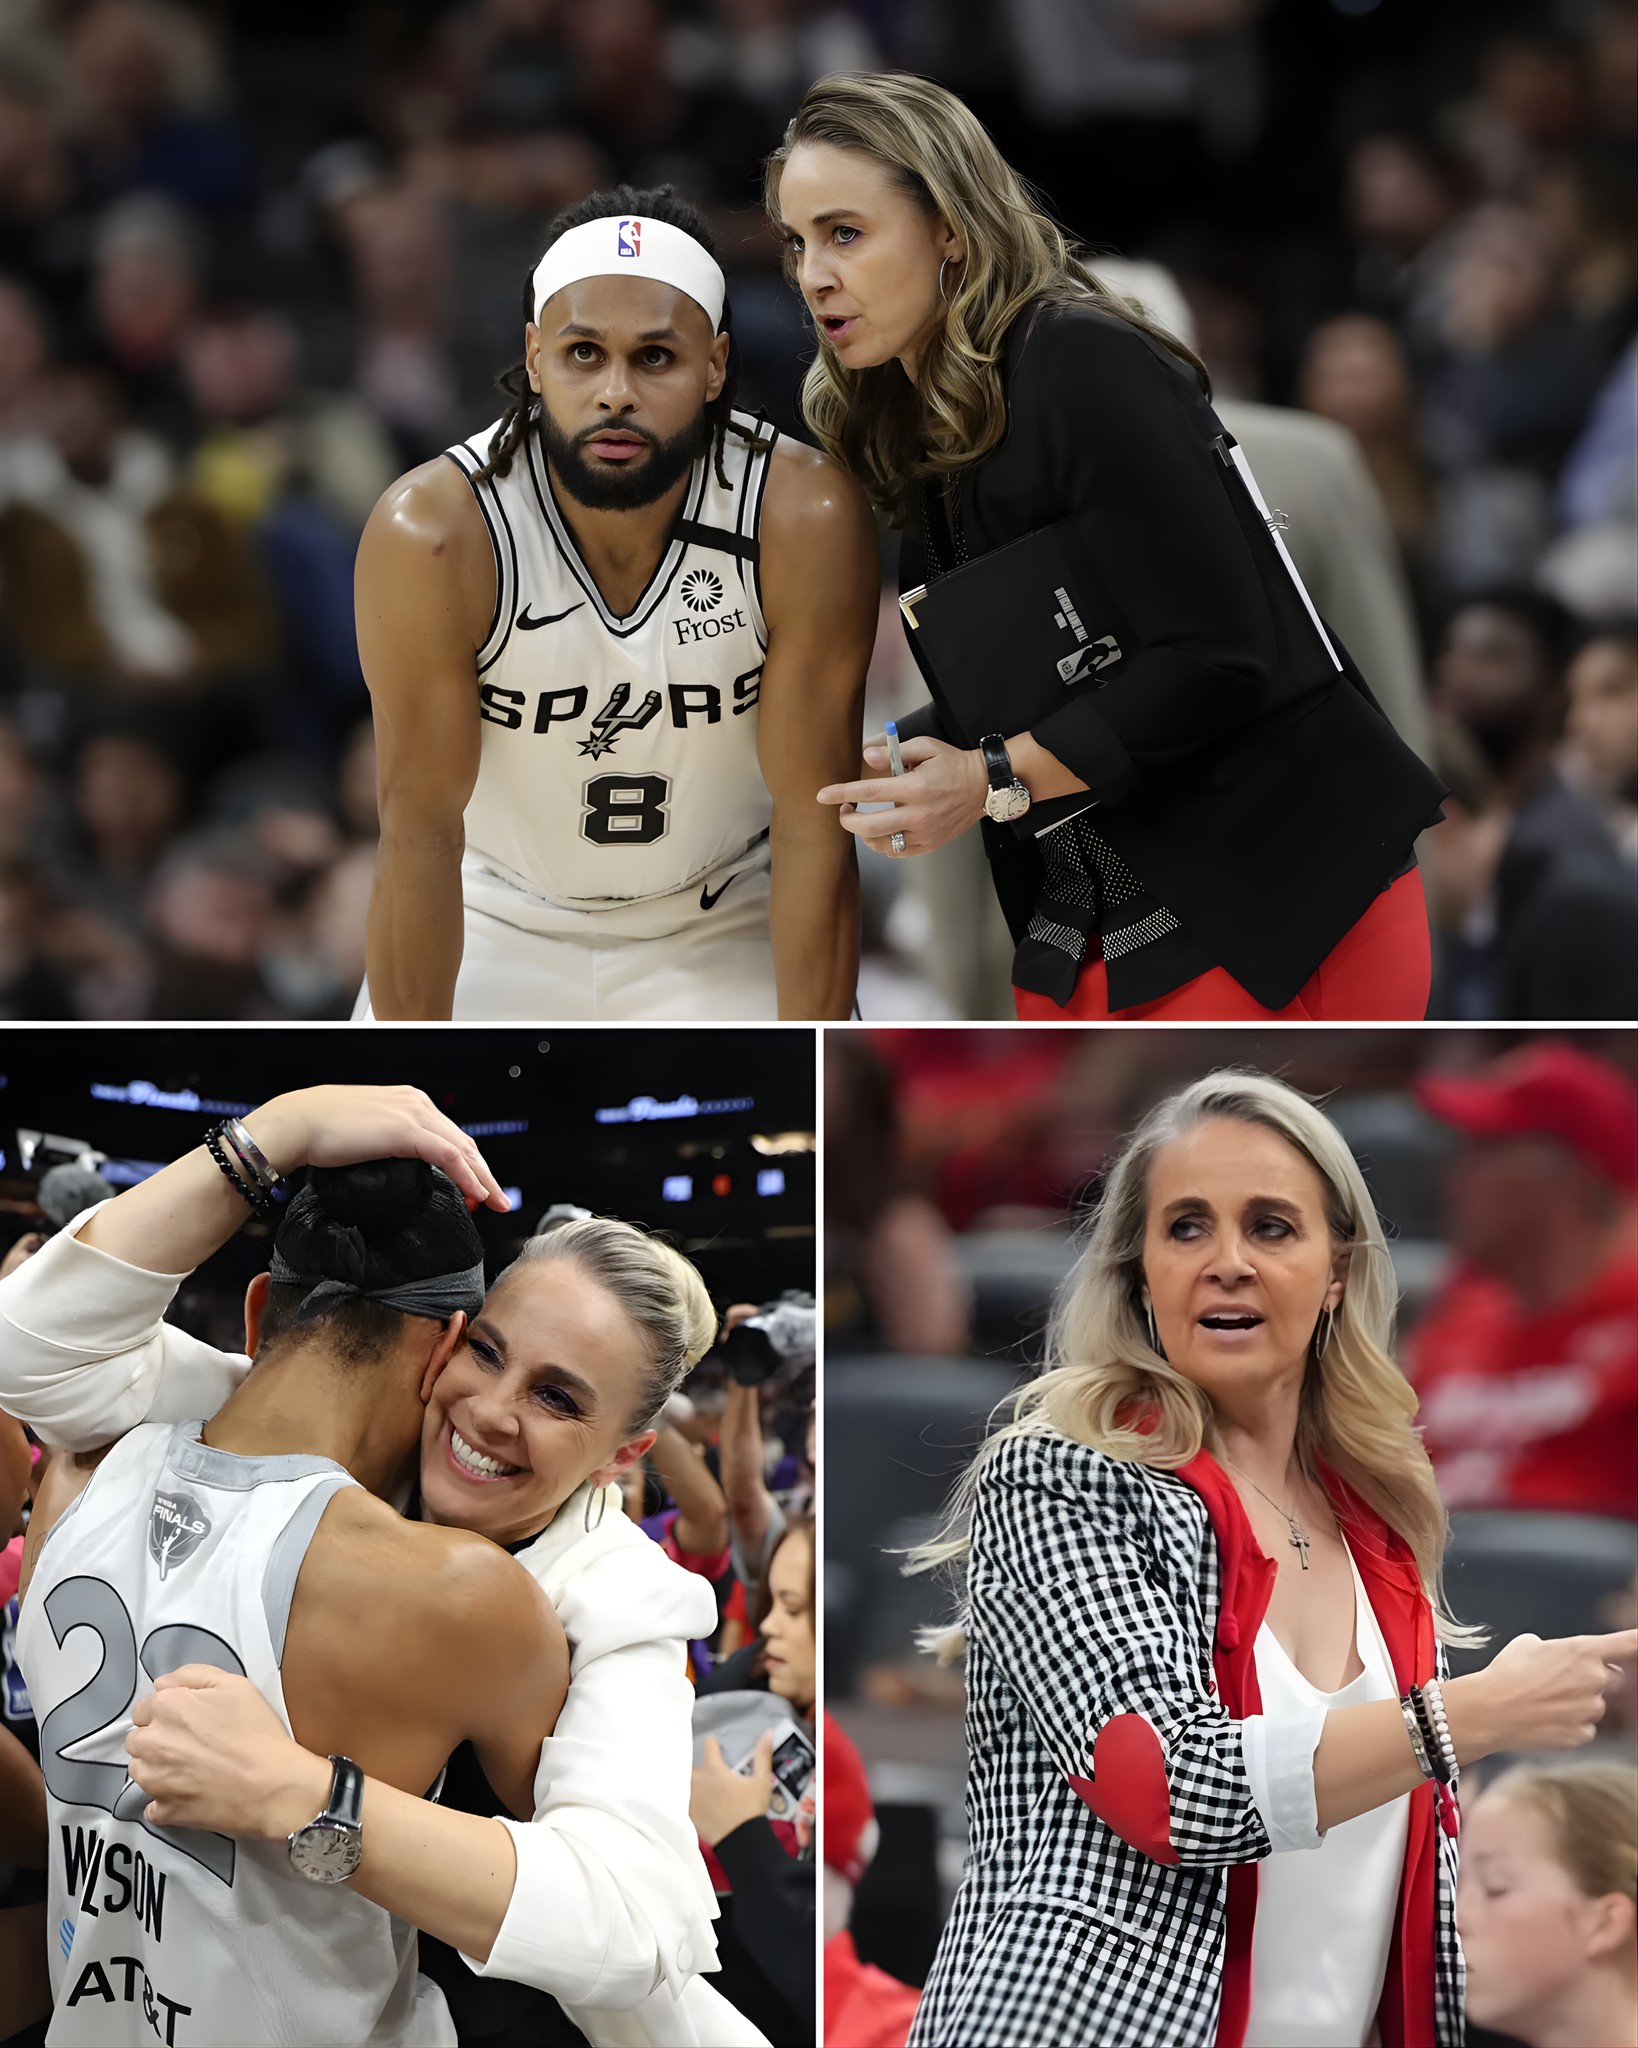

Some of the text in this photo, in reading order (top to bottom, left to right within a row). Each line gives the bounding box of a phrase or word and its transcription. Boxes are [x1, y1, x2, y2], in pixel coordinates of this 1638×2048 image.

[673, 608, 746, 646] Frost
[480, 660, 765, 761] SPURS
[579, 770, 673, 848] 8
[153, 1504, 206, 1535] FINALS
[66, 1956, 192, 2048] AT&T
